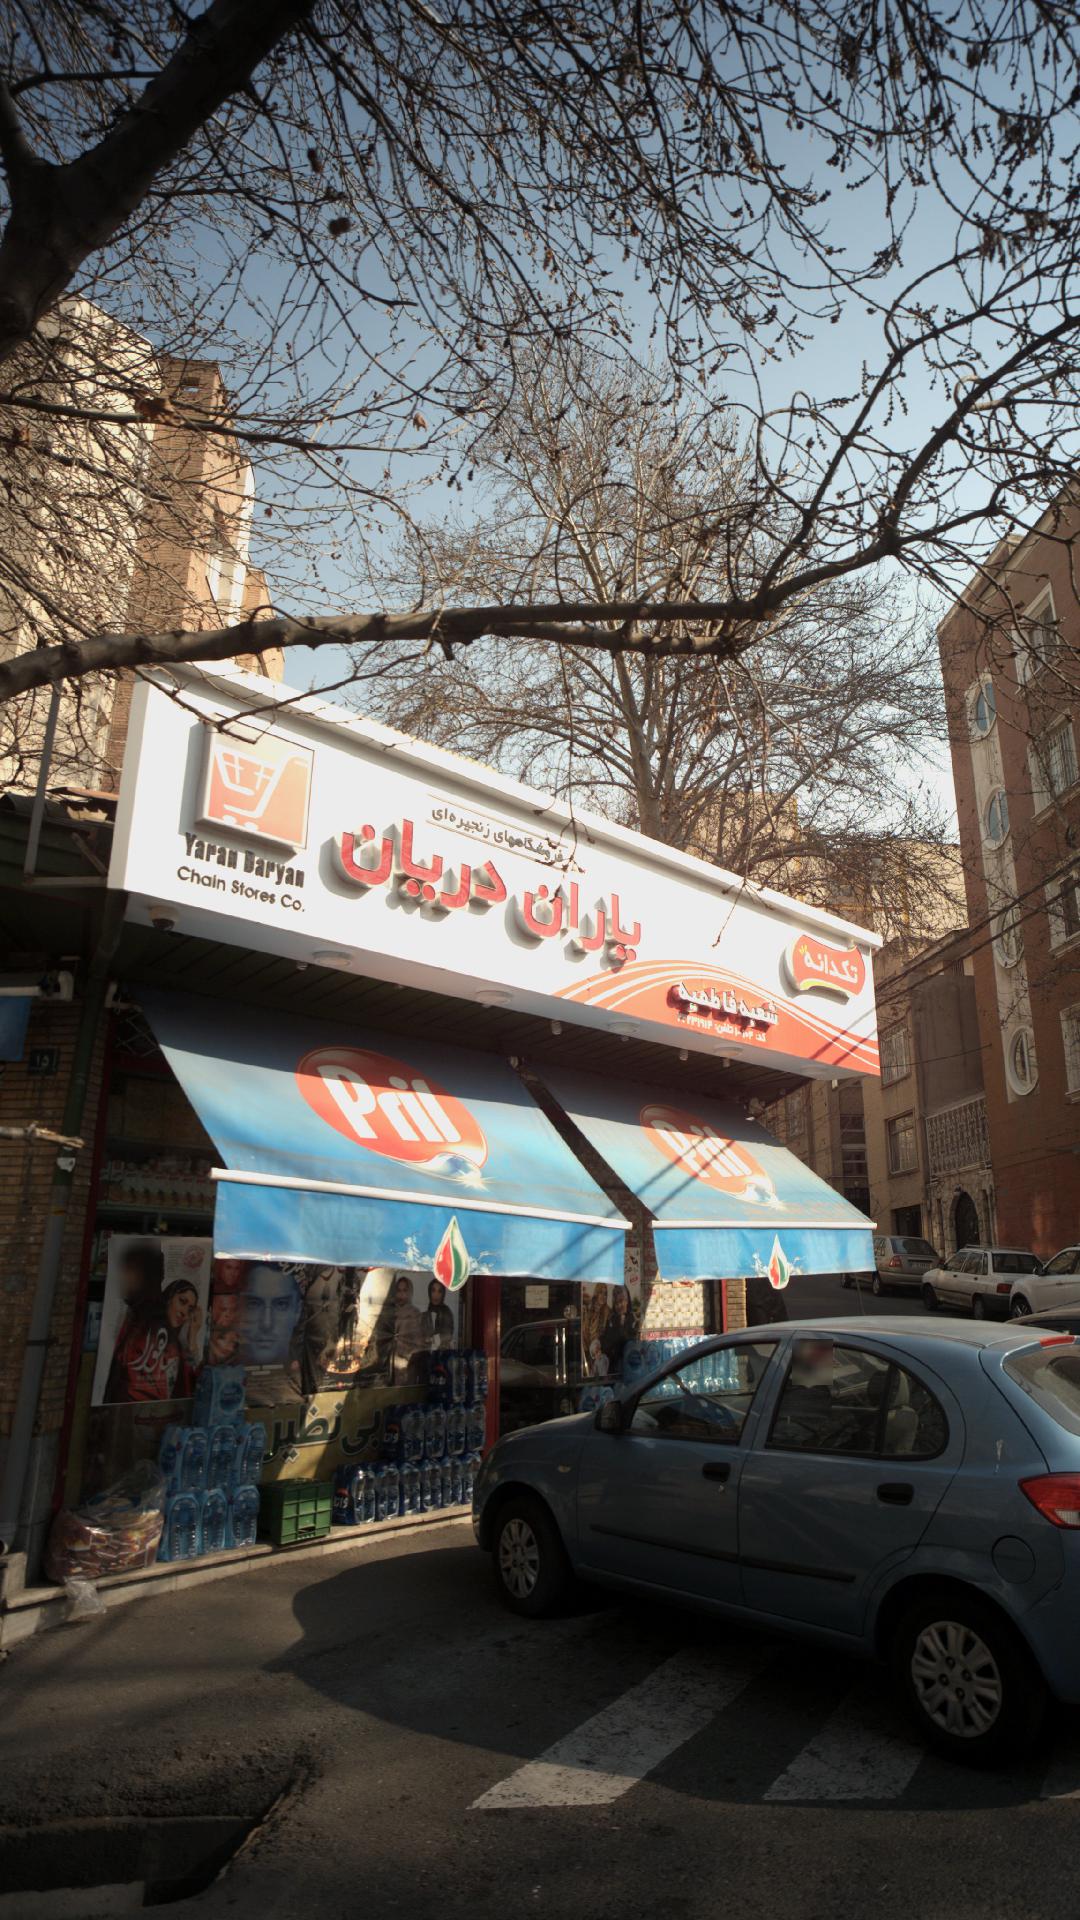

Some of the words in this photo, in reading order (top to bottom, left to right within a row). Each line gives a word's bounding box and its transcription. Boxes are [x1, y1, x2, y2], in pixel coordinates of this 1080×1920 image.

[176, 865, 226, 892] Chain
[231, 879, 276, 905] Stores
[280, 893, 305, 913] Co.
[185, 832, 238, 870] Yaran
[243, 849, 305, 889] Daryan
[341, 818, 507, 909] دریان
[523, 881, 641, 963] یاران
[804, 951, 858, 984] تکدانه
[678, 981, 738, 1014] فاطمیه
[740, 1001, 779, 1027] شعبه
[316, 1064, 462, 1143] Pril
[650, 1119, 753, 1178] Pril
